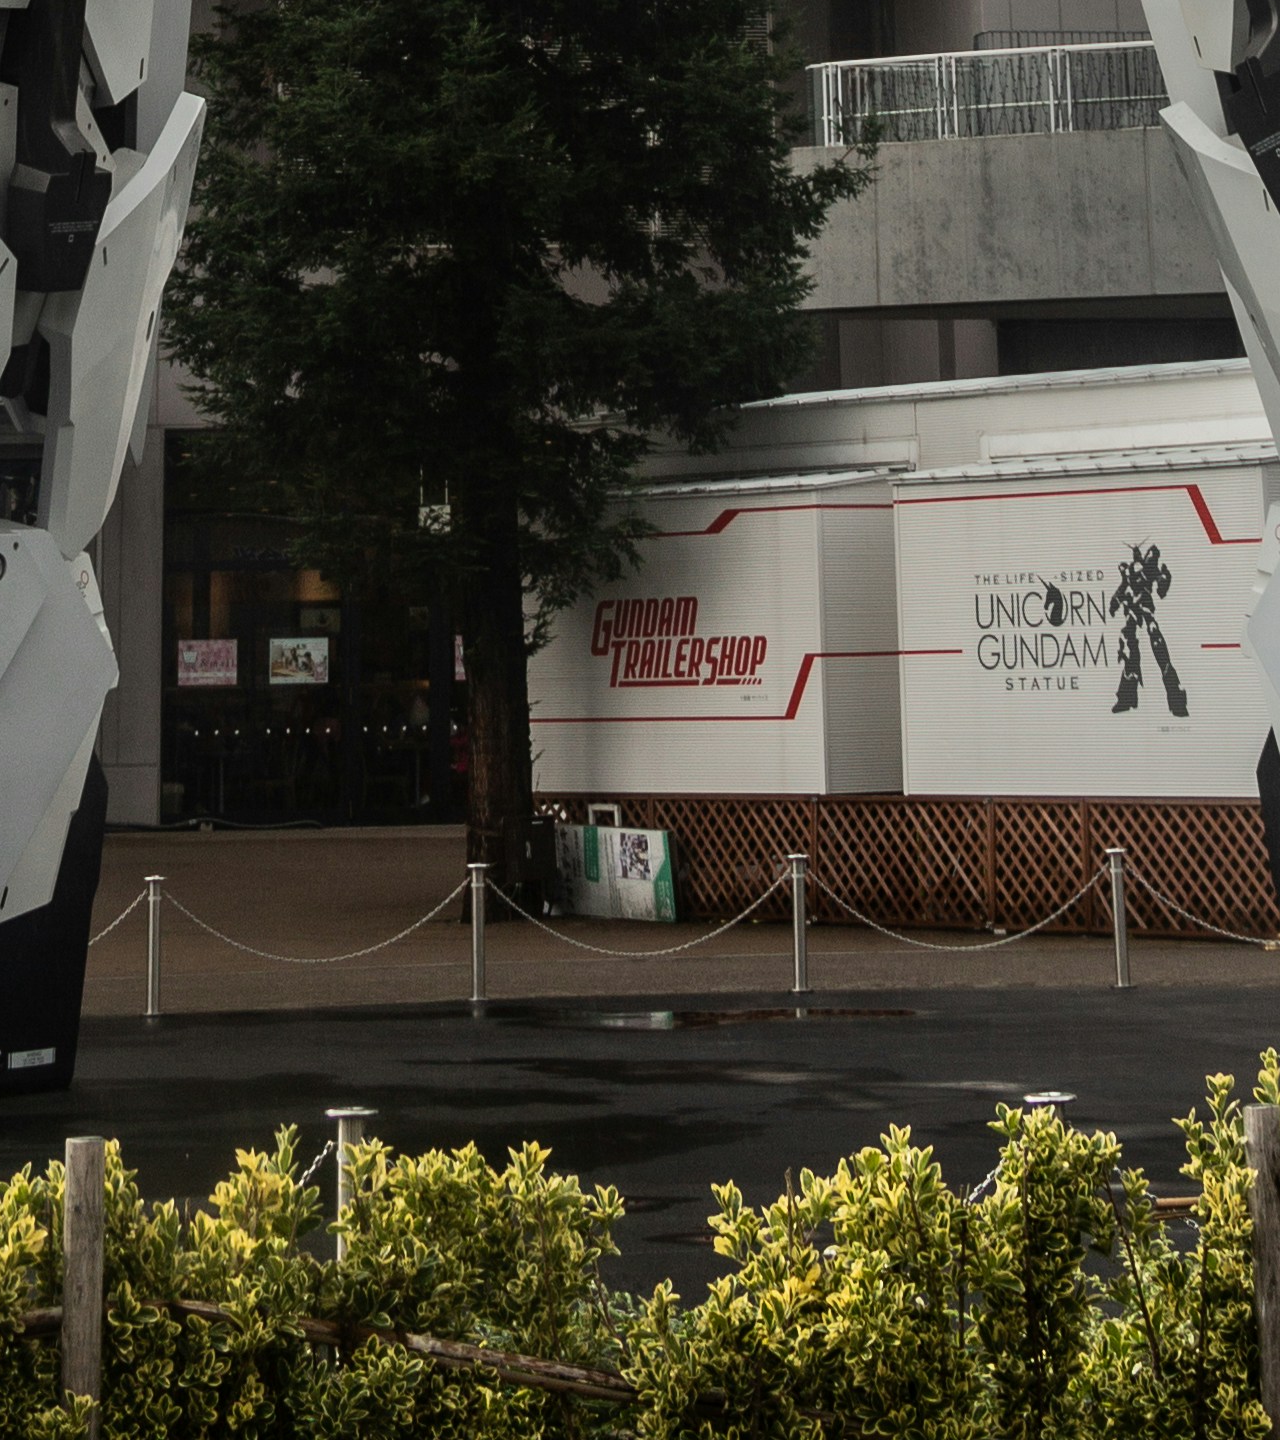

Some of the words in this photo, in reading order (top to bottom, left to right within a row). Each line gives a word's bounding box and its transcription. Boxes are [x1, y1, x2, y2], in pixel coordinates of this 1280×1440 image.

[975, 575, 1000, 585] THE
[1006, 573, 1035, 585] LIFE
[590, 596, 699, 657] GUNDAM
[975, 590, 1107, 629] UNICORN
[978, 633, 1108, 670] GUNDAM
[1005, 677, 1080, 691] STATUE
